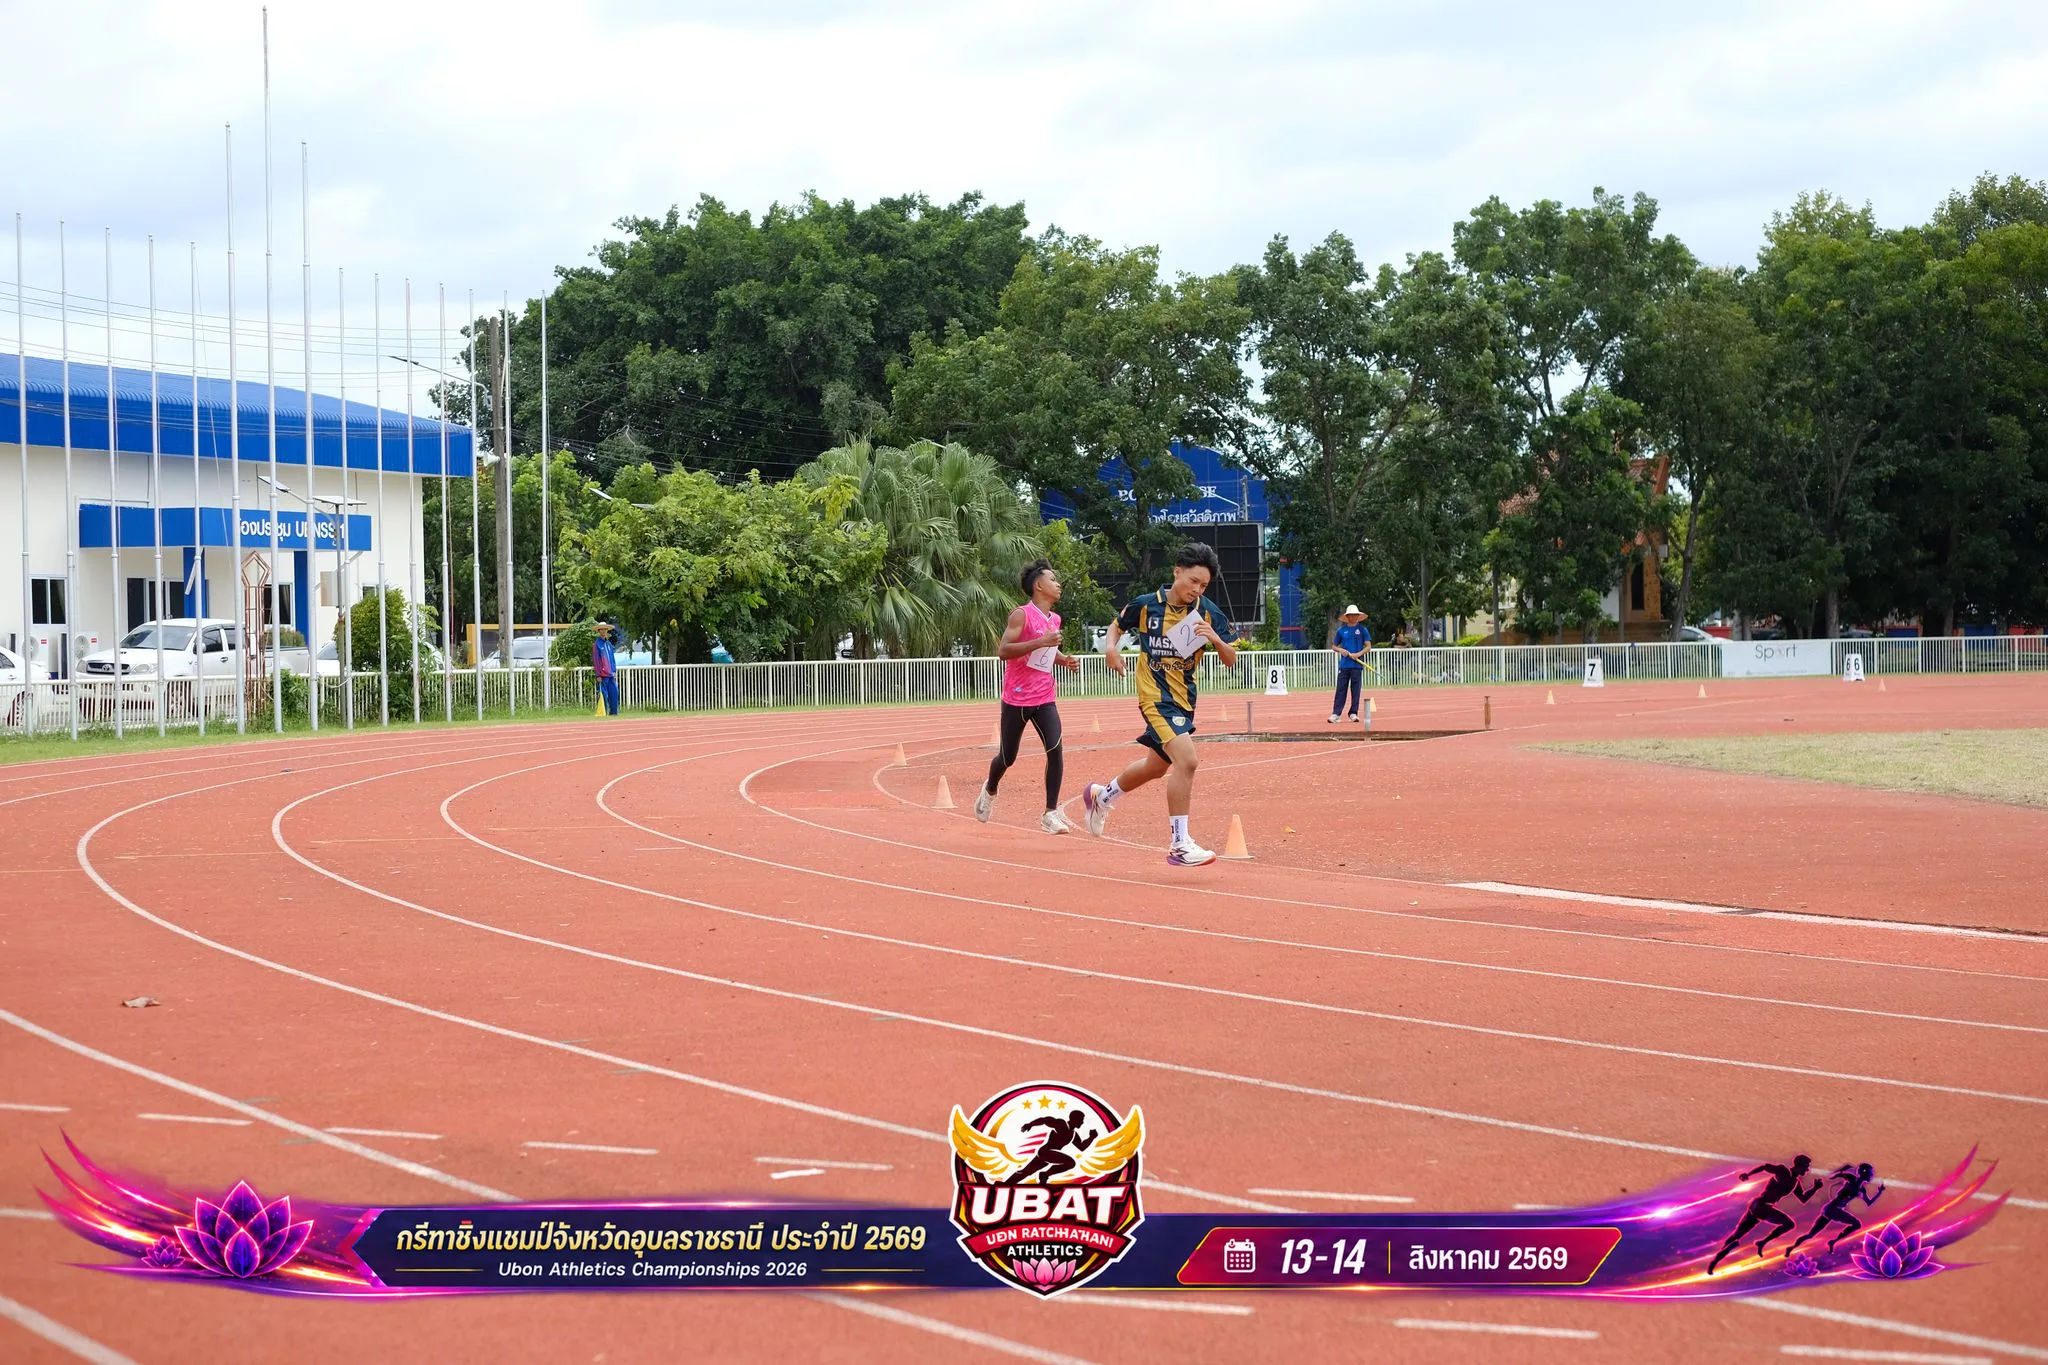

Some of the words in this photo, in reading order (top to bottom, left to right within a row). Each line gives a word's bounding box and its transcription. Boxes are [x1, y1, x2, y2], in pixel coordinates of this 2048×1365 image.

[1180, 624, 1198, 647] 2
[1588, 663, 1597, 677] 7
[1854, 657, 1860, 671] 6
[1271, 669, 1278, 684] 8
